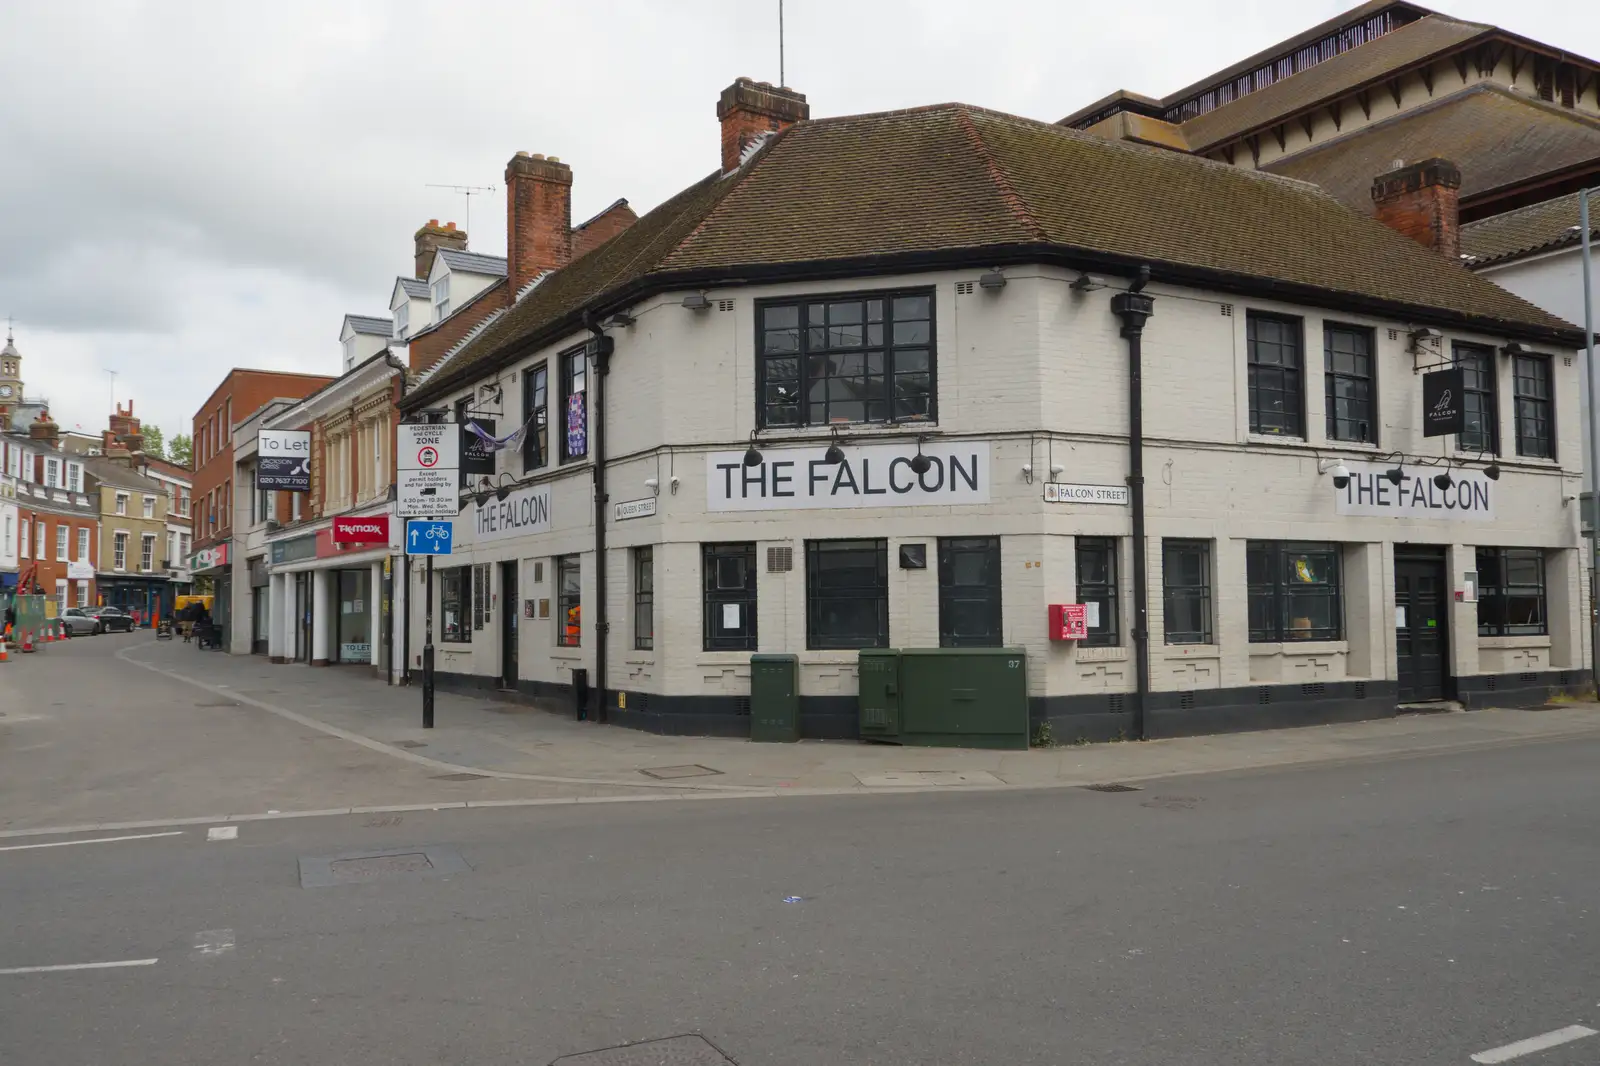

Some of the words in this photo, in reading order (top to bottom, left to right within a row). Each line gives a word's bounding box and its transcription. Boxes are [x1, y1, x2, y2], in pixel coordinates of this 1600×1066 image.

[261, 438, 279, 450] To
[284, 438, 308, 451] Let
[716, 461, 795, 499] THE
[808, 454, 978, 497] FALCON
[1060, 488, 1094, 498] FALCON
[1096, 489, 1126, 500] STREET
[1347, 472, 1391, 506] THE
[1398, 475, 1489, 511] FALCON
[476, 505, 497, 534] THE
[499, 493, 548, 531] FALCON
[623, 504, 638, 515] QUEEN
[638, 501, 655, 513] STREET
[1008, 659, 1021, 669] 37
